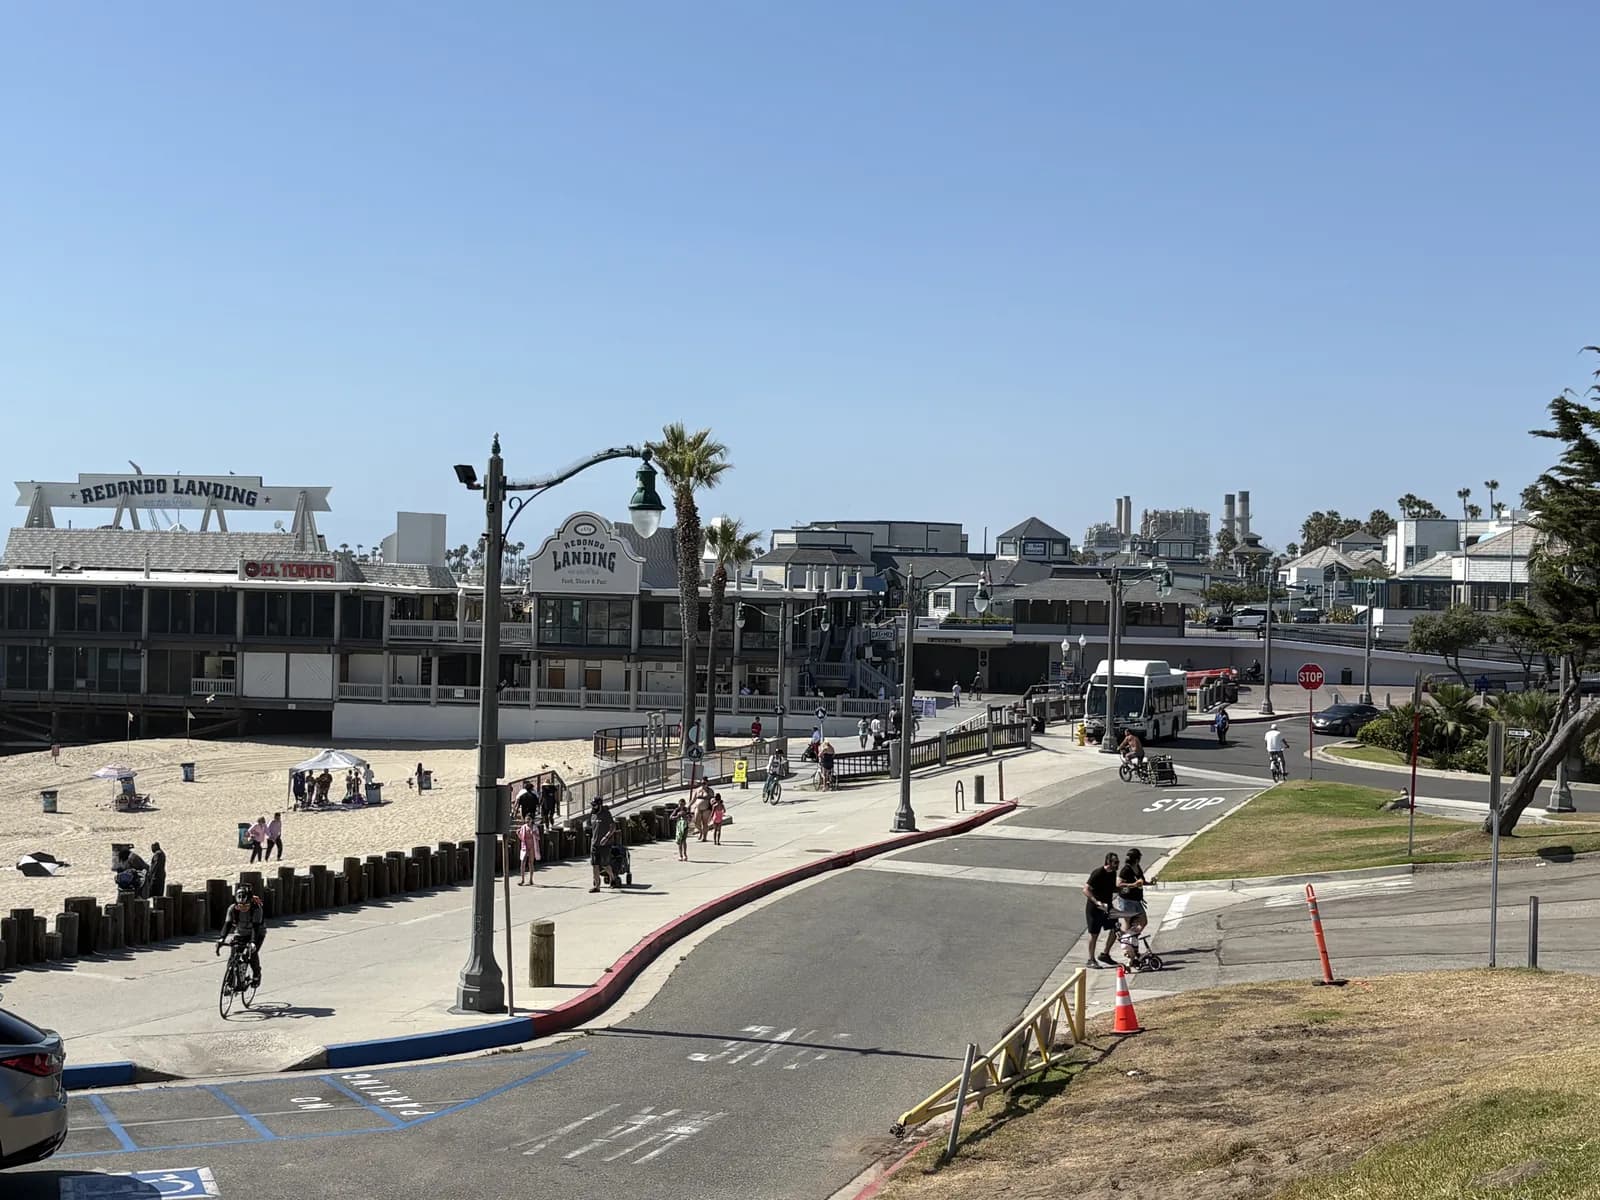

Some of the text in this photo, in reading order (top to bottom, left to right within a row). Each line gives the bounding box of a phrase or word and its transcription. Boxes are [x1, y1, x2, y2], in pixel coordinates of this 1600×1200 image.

[80, 479, 167, 504] REDONDO
[173, 479, 258, 507] LANDING
[564, 539, 605, 550] REDONDO
[552, 551, 617, 573] LANDING
[261, 562, 335, 579] EL TORITO
[1299, 671, 1323, 683] STOP
[1142, 797, 1225, 812] STOP
[341, 1073, 435, 1115] PARKING
[290, 1096, 334, 1110] NO
